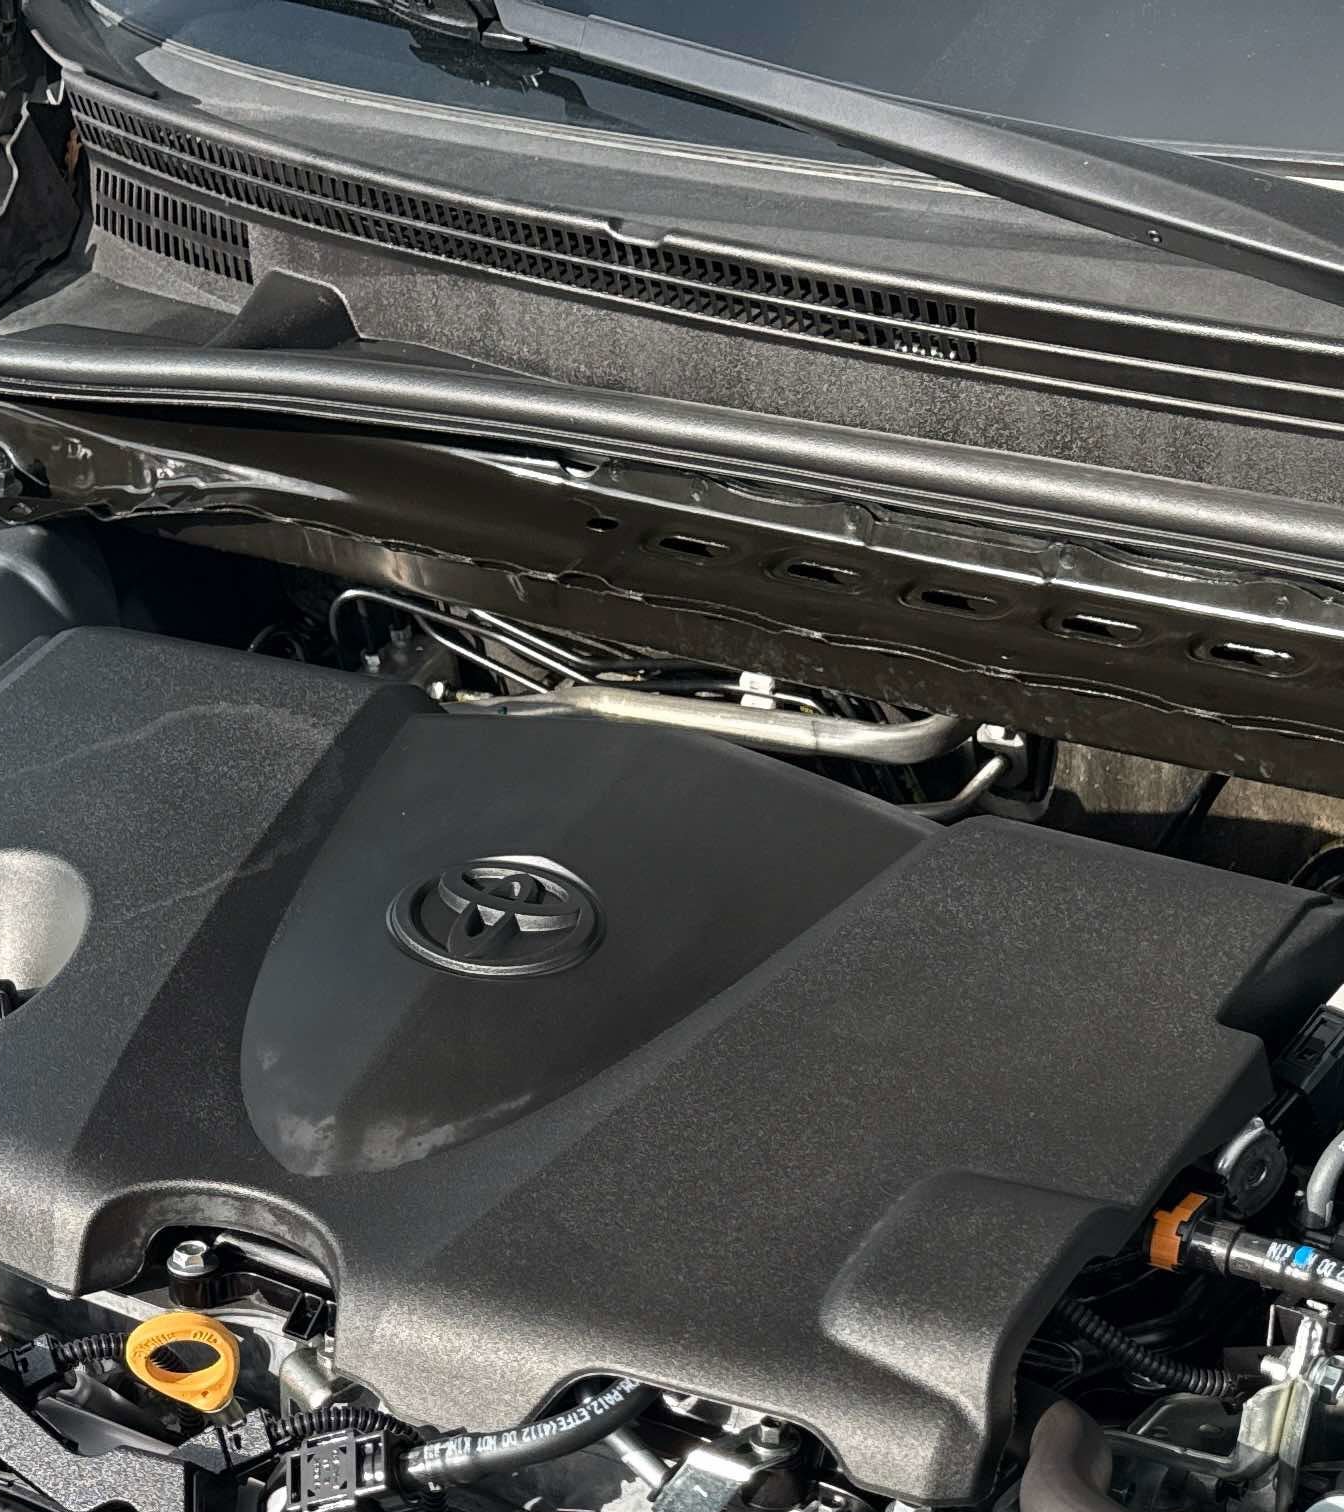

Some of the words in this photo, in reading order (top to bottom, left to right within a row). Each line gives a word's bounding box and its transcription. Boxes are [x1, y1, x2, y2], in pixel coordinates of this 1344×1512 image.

[1316, 1259, 1335, 1278] DO
[476, 1435, 497, 1453] NOT
[501, 1431, 518, 1449] DO
